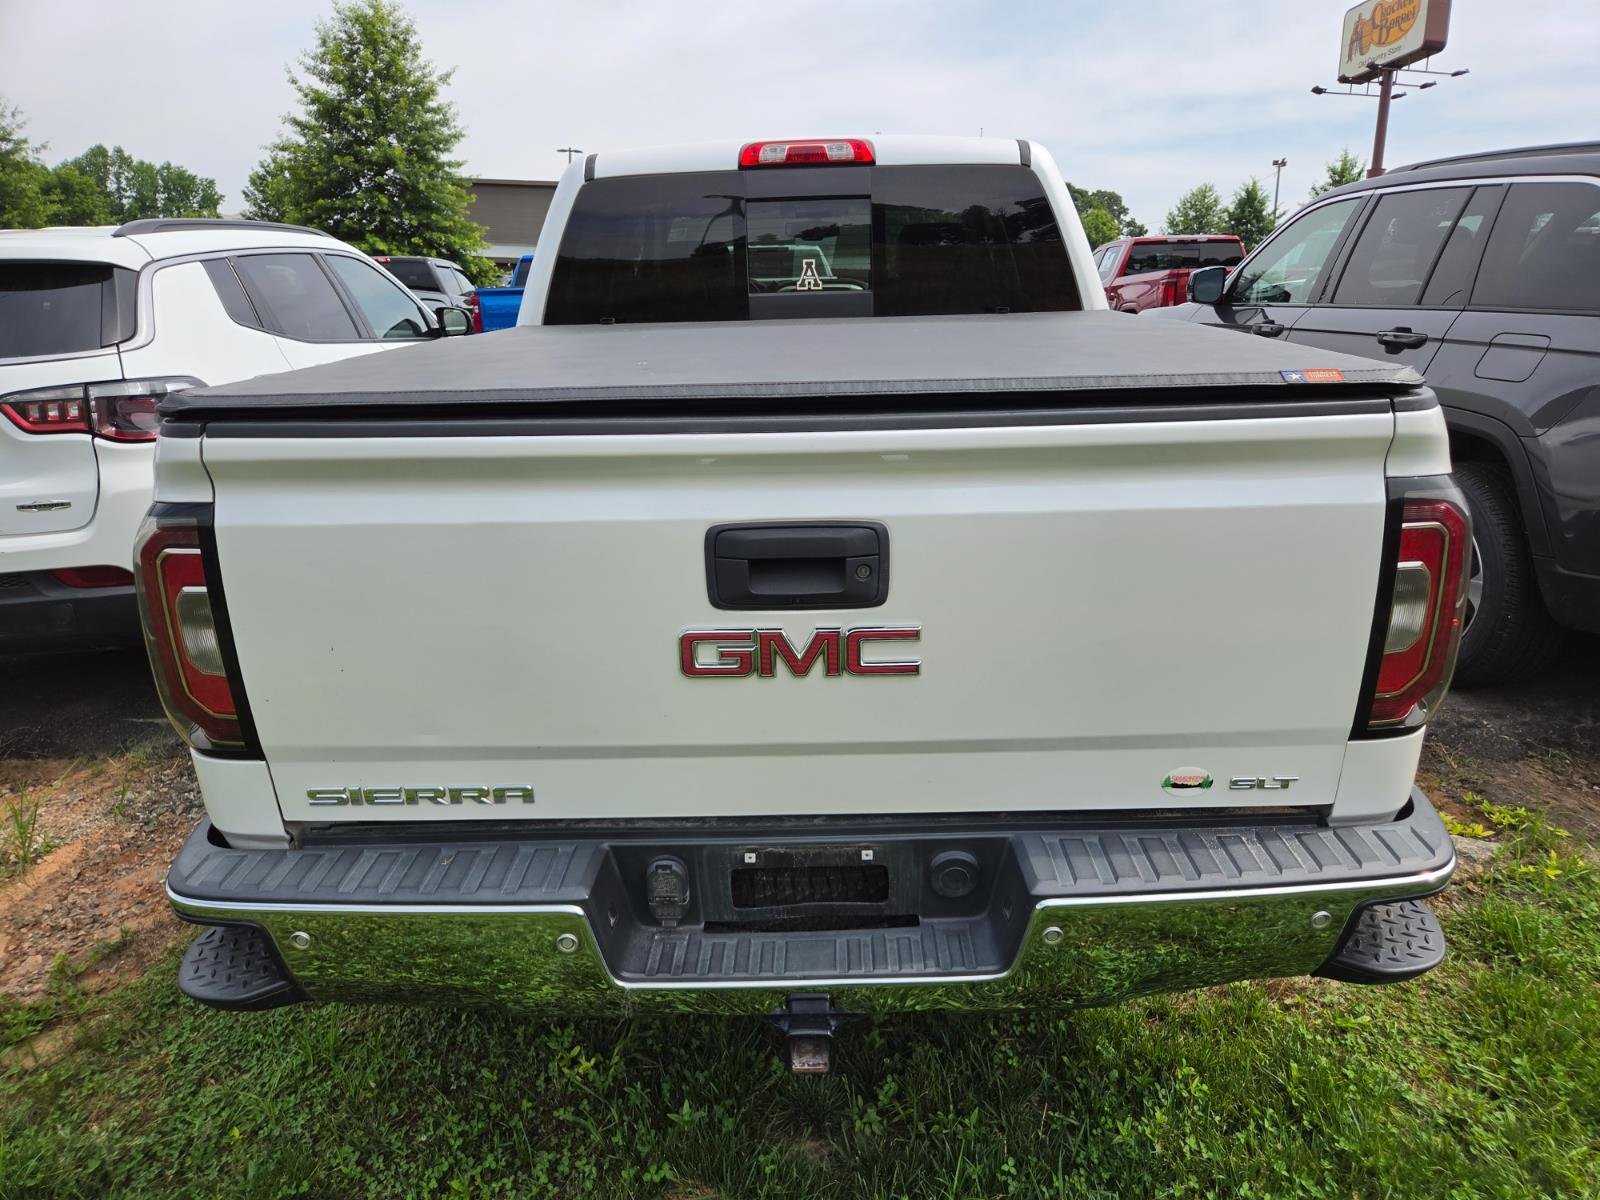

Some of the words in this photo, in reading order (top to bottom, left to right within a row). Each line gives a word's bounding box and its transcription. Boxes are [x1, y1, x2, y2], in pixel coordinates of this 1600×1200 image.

[679, 625, 922, 678] GMC
[1229, 776, 1300, 790] SLT
[306, 784, 535, 806] SIERRA
